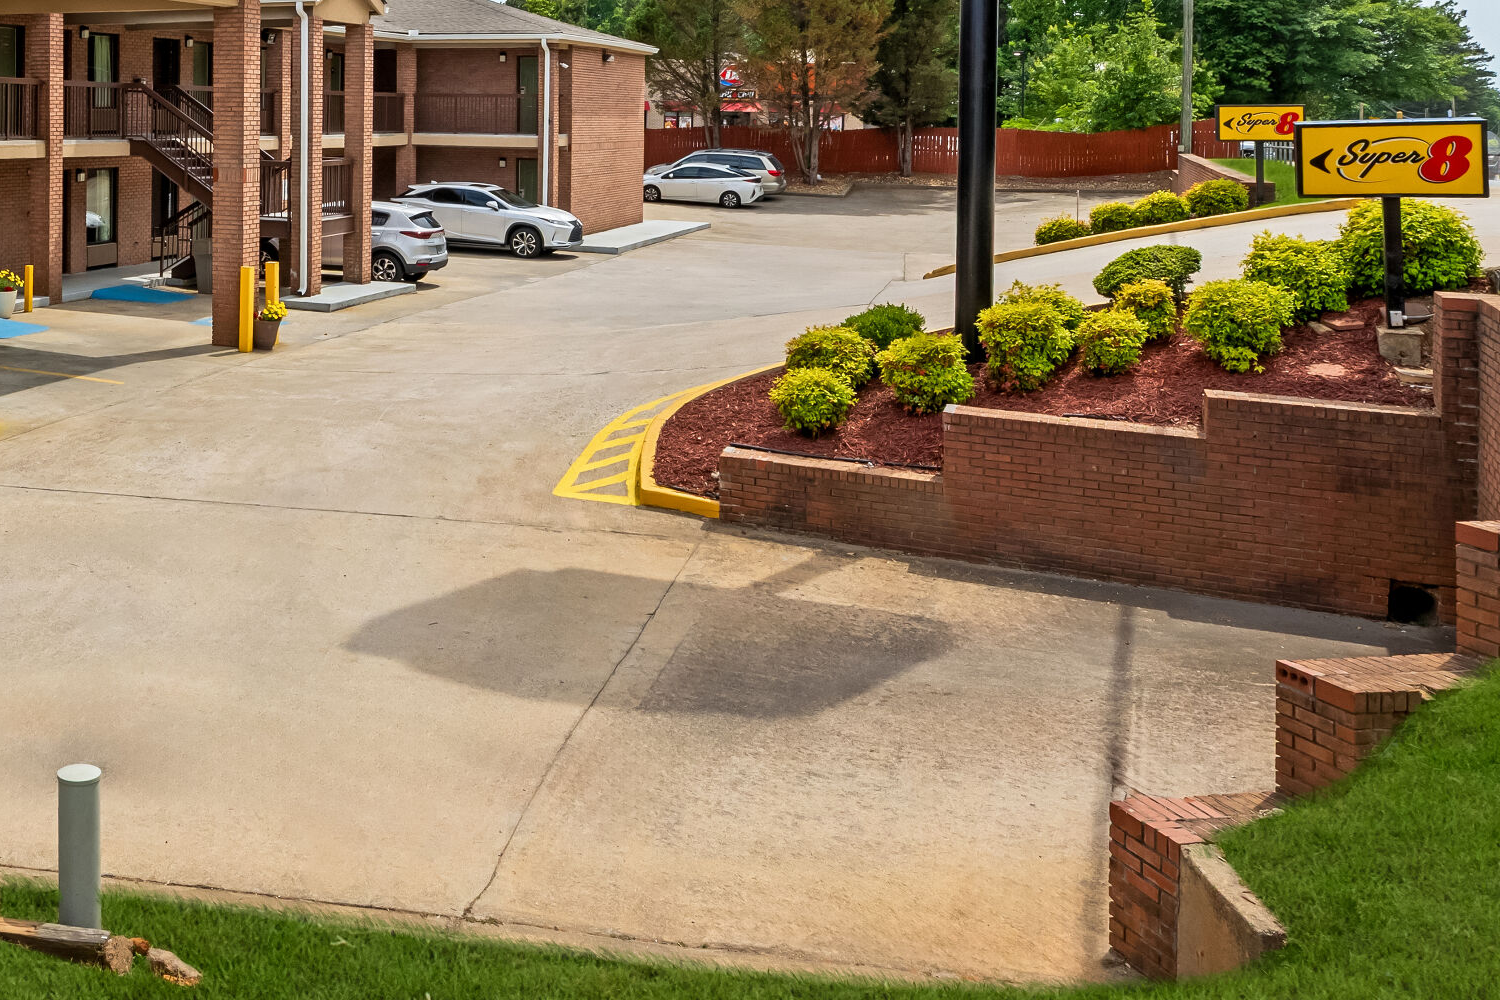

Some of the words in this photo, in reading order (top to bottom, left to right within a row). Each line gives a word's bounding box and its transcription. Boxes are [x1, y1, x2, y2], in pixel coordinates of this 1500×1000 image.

[1236, 112, 1278, 133] Super
[1274, 112, 1300, 135] 8
[1336, 138, 1426, 179] Super
[1418, 135, 1473, 184] 8
